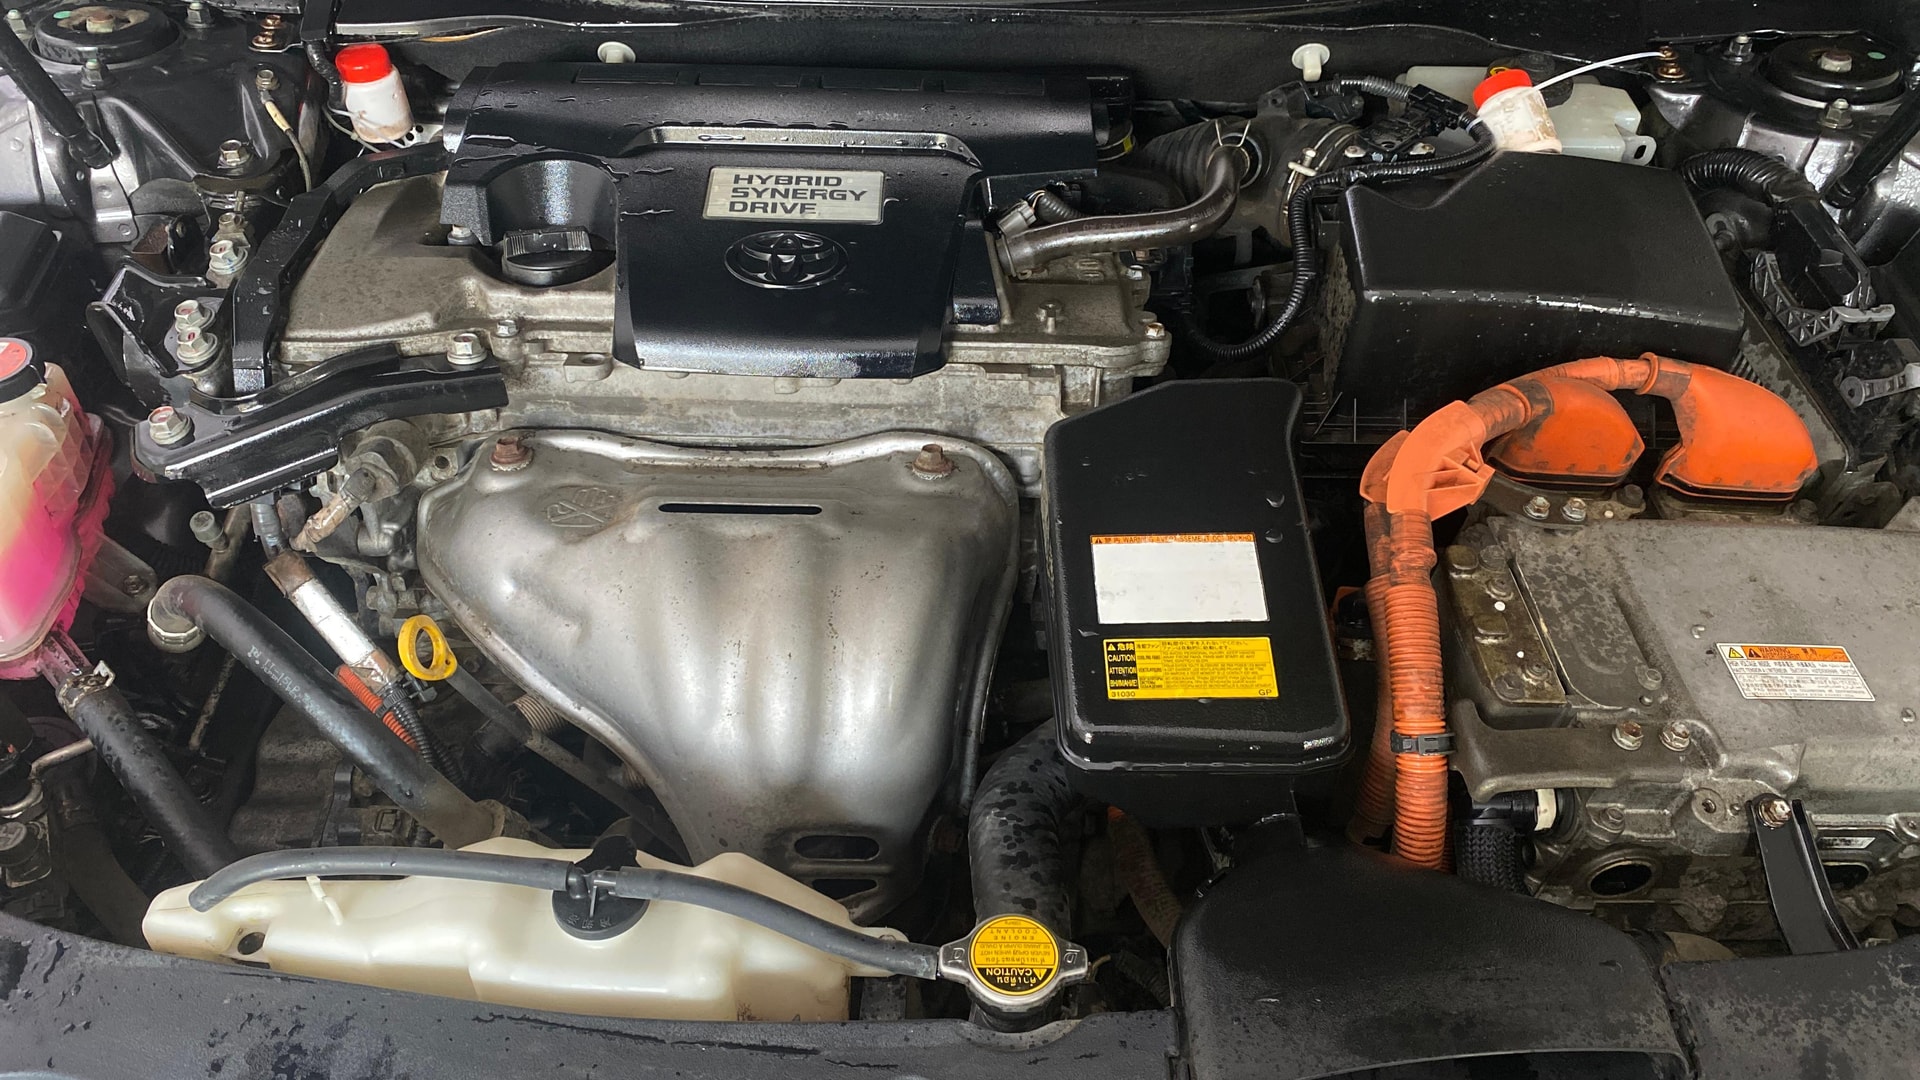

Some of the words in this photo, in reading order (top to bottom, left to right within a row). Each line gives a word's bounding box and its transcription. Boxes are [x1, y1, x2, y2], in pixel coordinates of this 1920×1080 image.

[733, 174, 842, 187] HYBRID
[731, 187, 868, 202] SYNERGY
[729, 201, 817, 215] DRIVE
[1108, 654, 1136, 662] CAUTION
[1109, 666, 1137, 675] ATTENTION
[986, 968, 1033, 976] CAUTION
